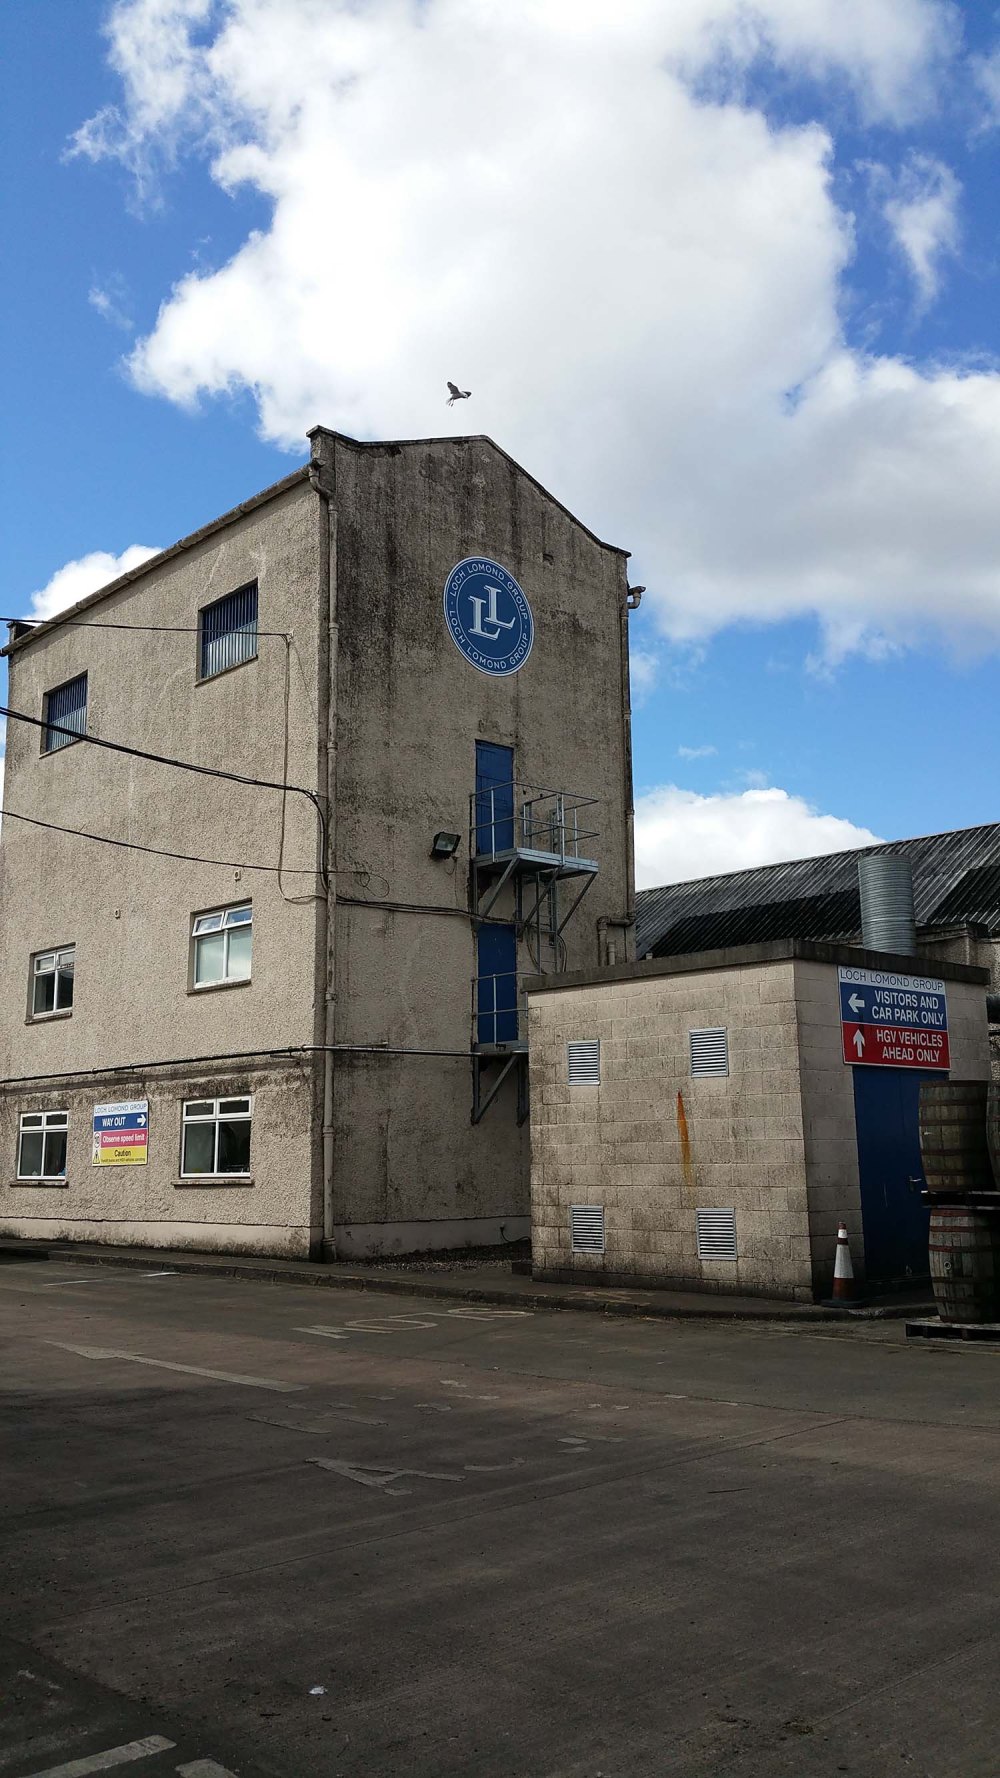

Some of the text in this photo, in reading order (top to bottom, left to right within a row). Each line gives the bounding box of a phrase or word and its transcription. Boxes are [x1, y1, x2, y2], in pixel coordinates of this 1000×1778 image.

[450, 563, 528, 620] LOCH LOMOND GROUP
[449, 610, 529, 669] LOCH LOMOND GROUP
[840, 969, 944, 991] LOCH LOMOND GROUP
[874, 990, 939, 1010] VISITORS AND
[872, 1006, 944, 1026] CAR PARK ONLY
[876, 1029, 943, 1048] HGV VEHICLES
[882, 1046, 940, 1063] AHEAD ONLY
[102, 1116, 126, 1127] WAY OUT
[114, 1149, 131, 1157] Caution
